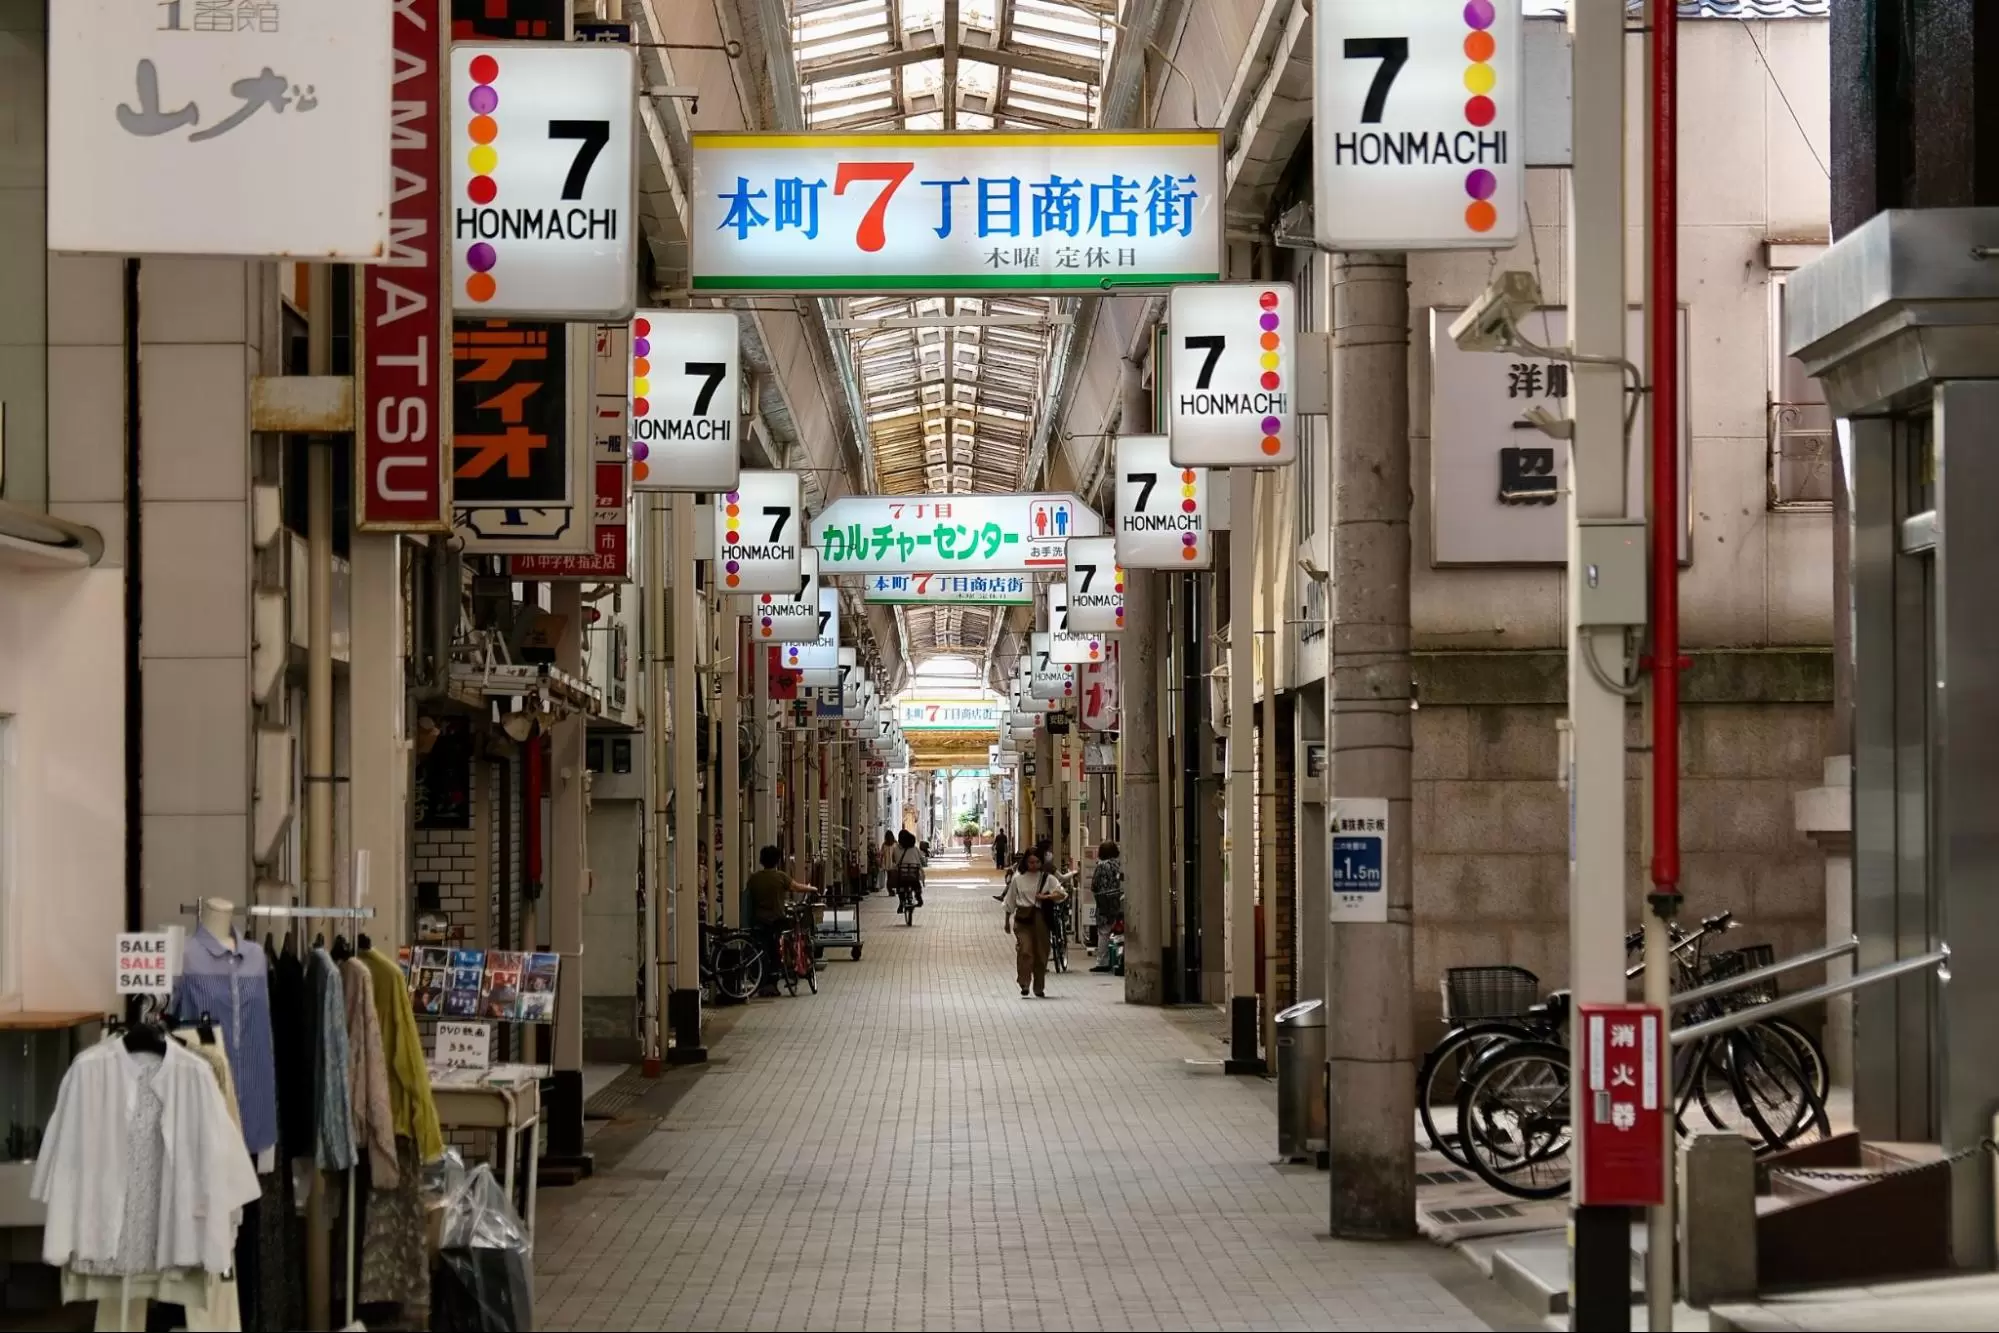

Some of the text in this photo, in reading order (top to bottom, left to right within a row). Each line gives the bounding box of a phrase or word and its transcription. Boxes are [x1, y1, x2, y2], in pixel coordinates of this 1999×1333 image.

[1344, 37, 1408, 123] 7
[1335, 131, 1507, 165] HONMACHI
[548, 120, 610, 200] 7
[716, 162, 1198, 254] 本町7丁目商店街
[456, 208, 617, 240] HONMACHI
[984, 247, 1137, 268] 木曜 定休日
[1185, 336, 1225, 389] 7
[685, 362, 726, 416] 7
[1181, 394, 1287, 415] HONMACHI
[1127, 473, 1157, 512] 7
[889, 503, 952, 519] 7丁目
[763, 506, 791, 543] 7
[1124, 515, 1202, 531] HONMACHI
[823, 522, 1018, 562] カルチャーセンター
[1030, 546, 1065, 557] お手洗
[721, 546, 794, 560] HONMACHI
[794, 575, 811, 602] 7
[874, 573, 1023, 594] 本町7丁目商店街
[1075, 565, 1096, 593] 7
[757, 605, 813, 616] HONMACHI
[1073, 595, 1124, 606] HONMACH
[1037, 652, 1049, 671] 7
[1035, 673, 1074, 681] HONMACHI
[881, 721, 890, 734] 7
[1344, 857, 1380, 880] 1.5m
[121, 940, 166, 953] SALE
[121, 957, 166, 970] SALE
[121, 974, 166, 987] SALE
